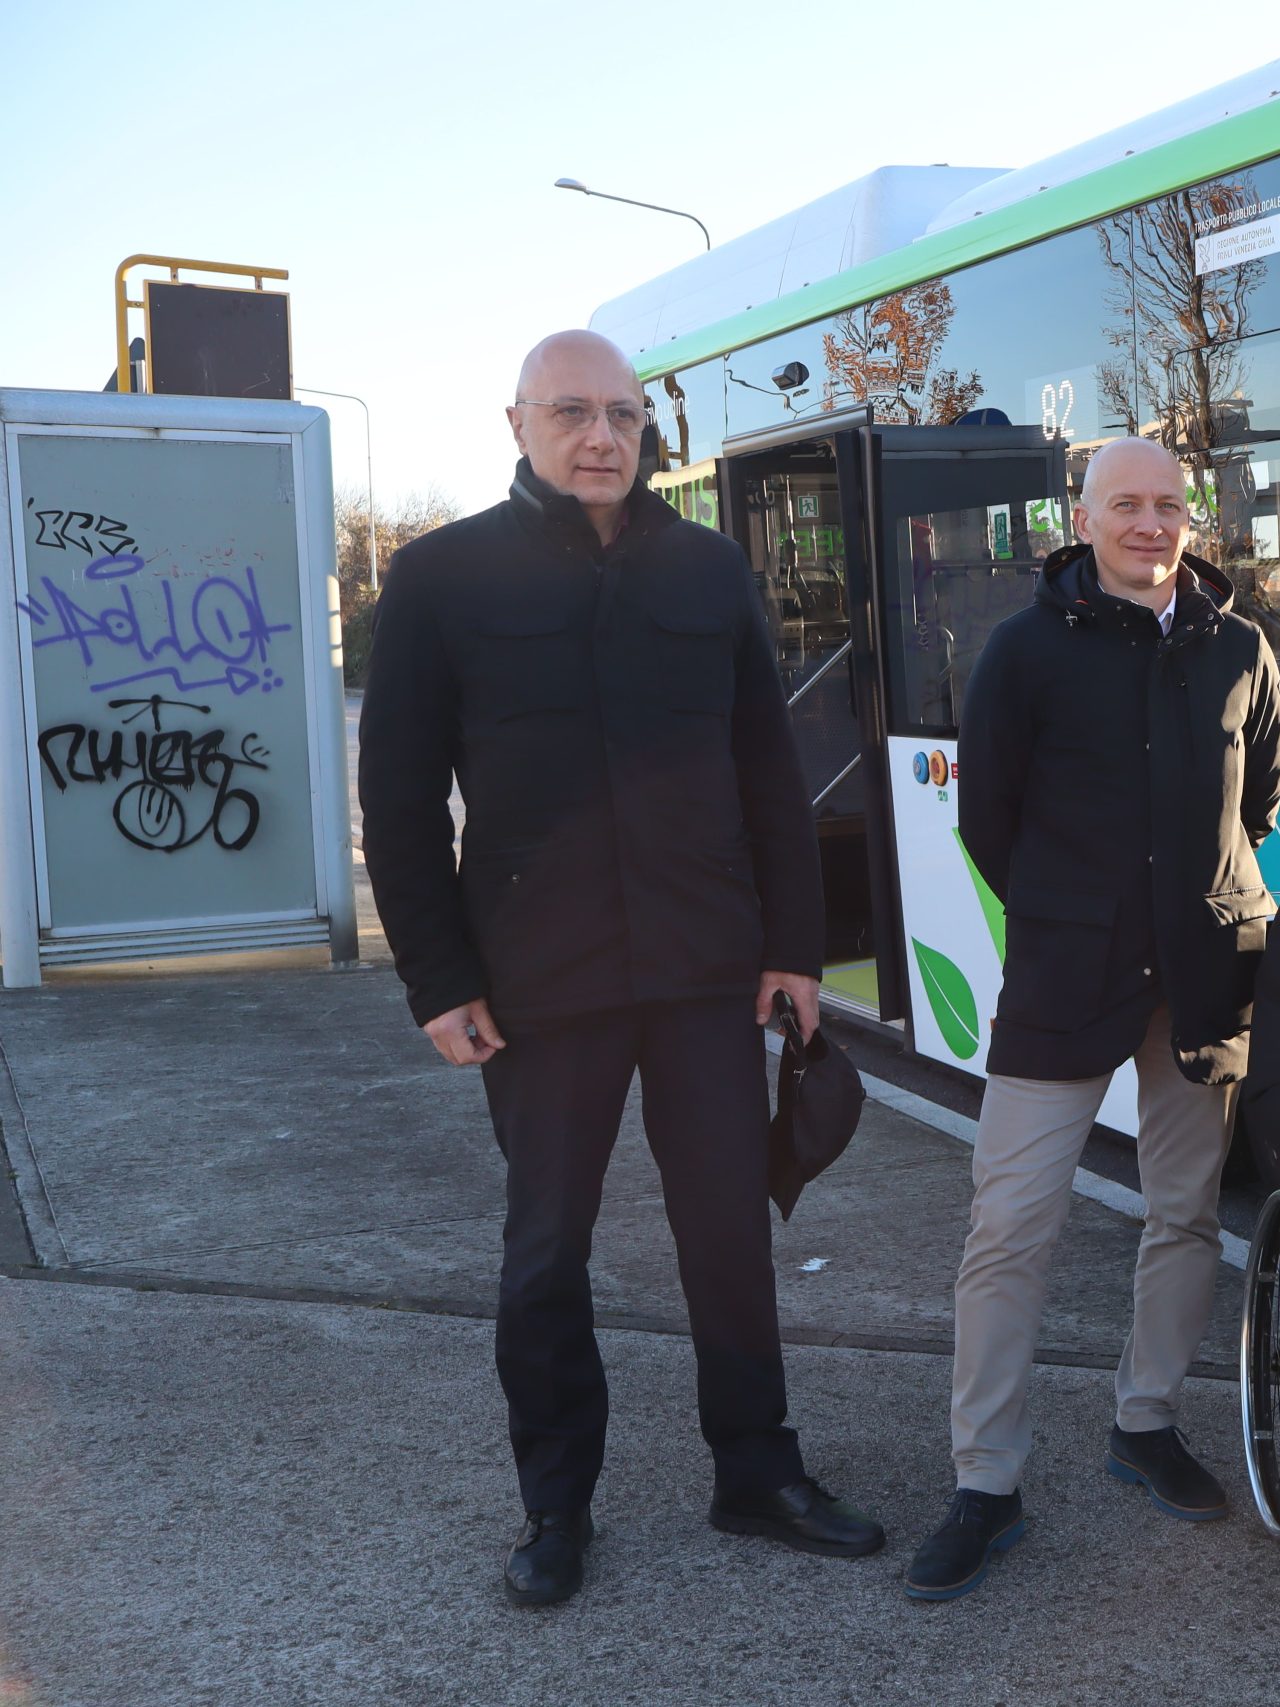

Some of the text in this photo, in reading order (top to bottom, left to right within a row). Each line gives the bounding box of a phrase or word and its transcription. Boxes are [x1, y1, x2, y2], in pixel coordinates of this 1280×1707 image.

[1194, 213, 1228, 234] TRASPORTO
[1228, 203, 1257, 223] PUBBLICO
[1041, 379, 1076, 441] 82
